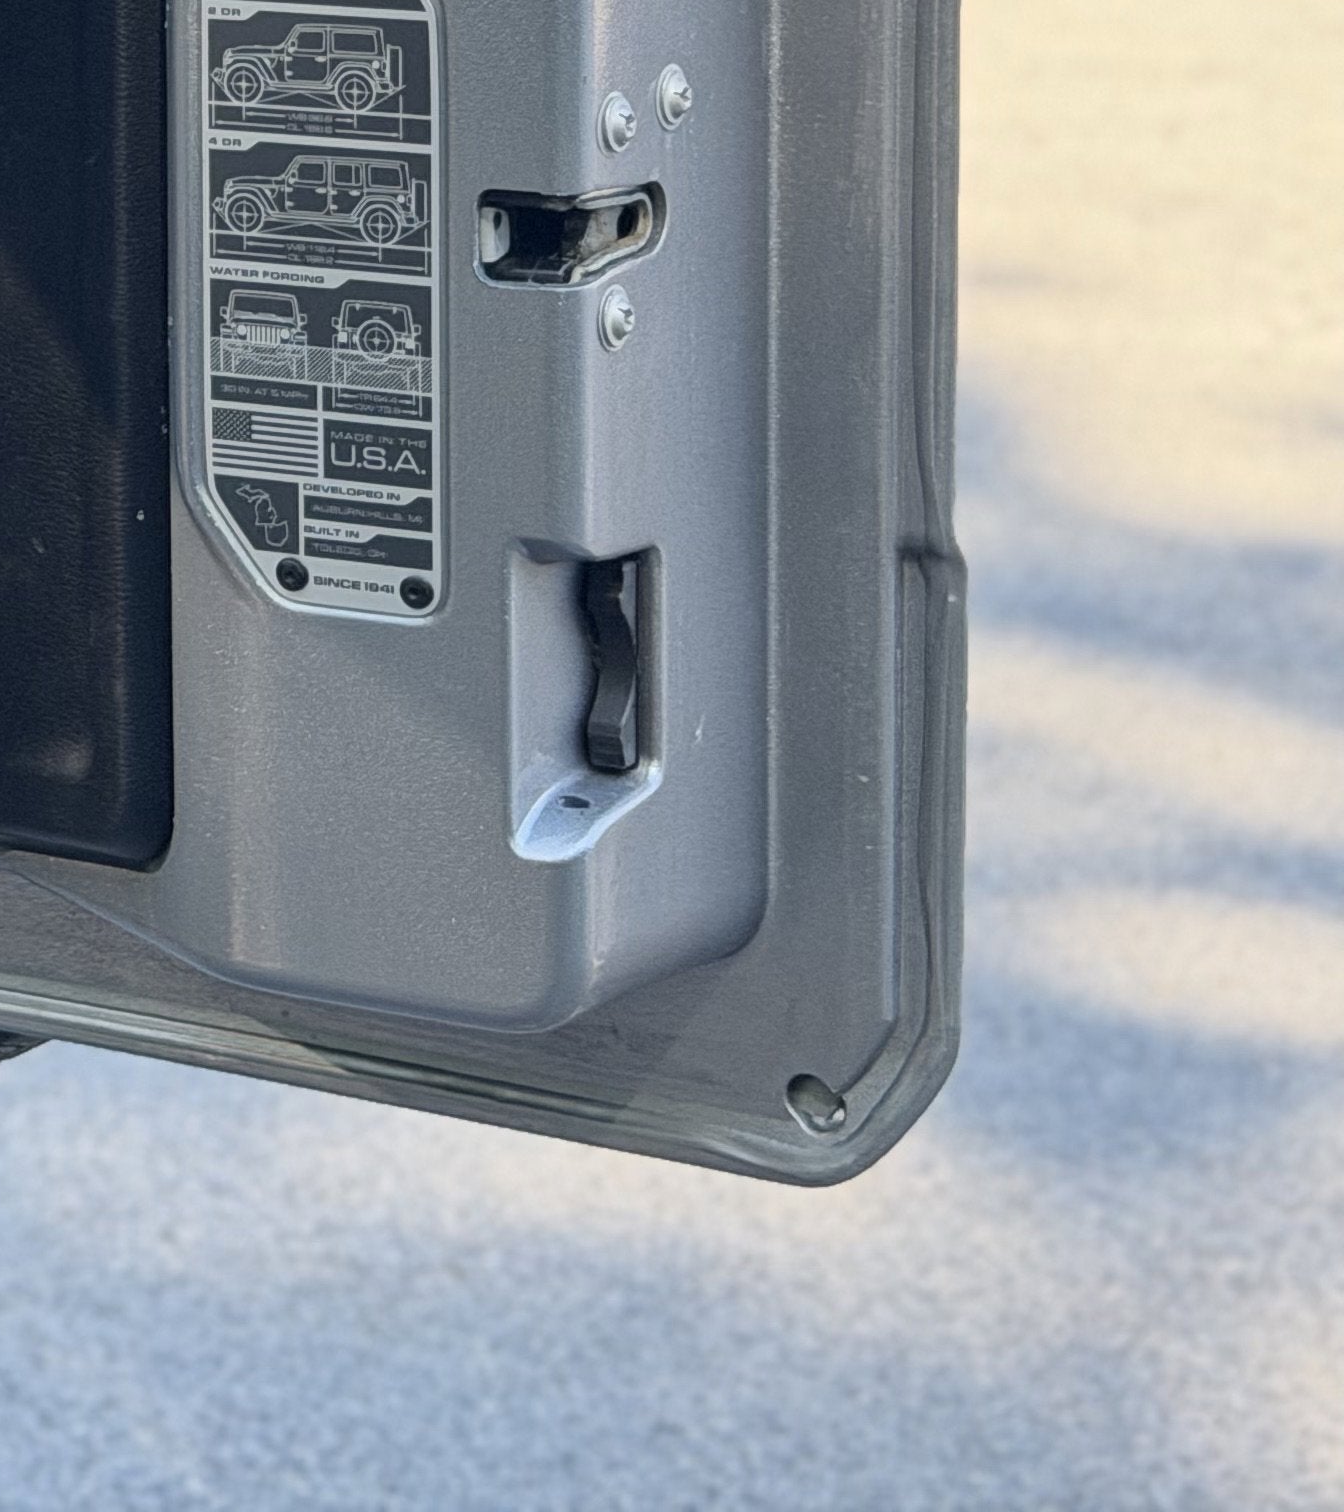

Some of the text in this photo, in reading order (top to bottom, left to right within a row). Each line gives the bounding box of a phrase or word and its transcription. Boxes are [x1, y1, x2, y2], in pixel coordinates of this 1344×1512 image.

[220, 7, 241, 17] DR
[208, 136, 242, 147] 4 DR
[210, 266, 325, 284] WATER FORDING
[330, 431, 427, 448] MADE IN THE
[330, 442, 427, 475] U.S.A.
[303, 483, 401, 501] DEVELOPED IN
[304, 525, 360, 539] BUILT IN
[313, 575, 361, 591] SINCE
